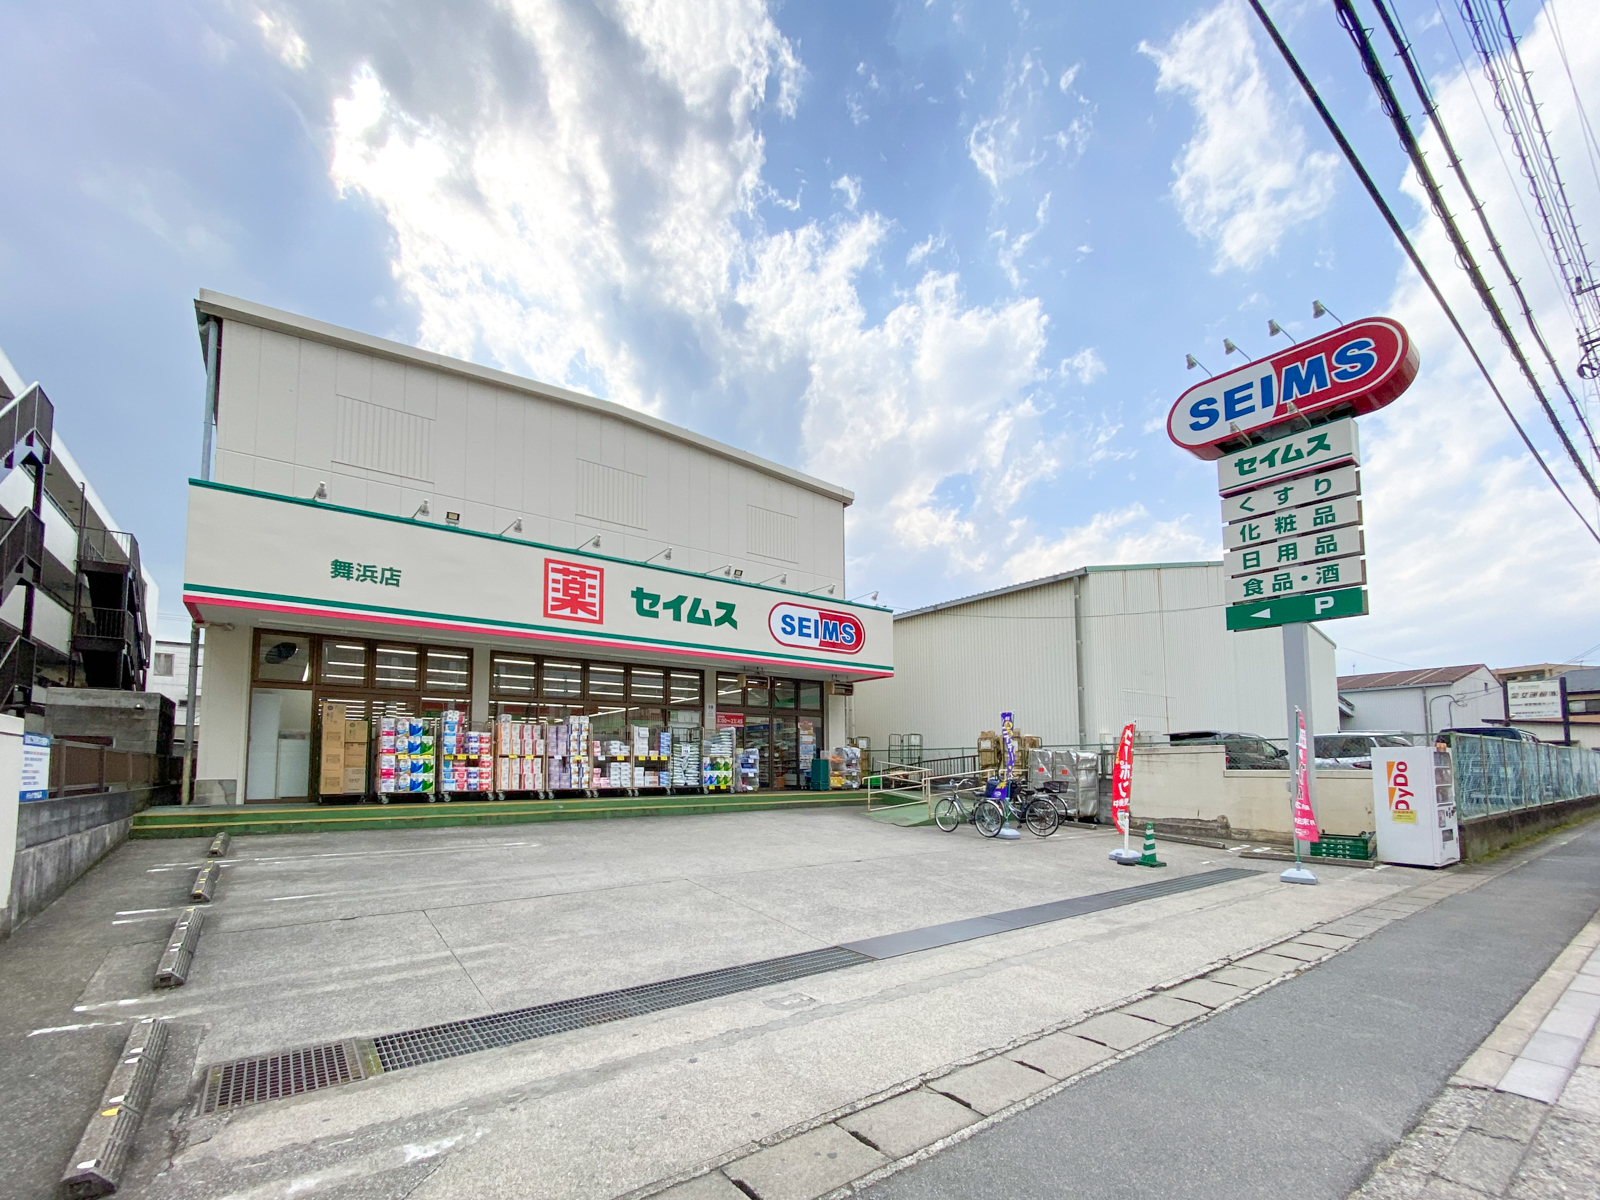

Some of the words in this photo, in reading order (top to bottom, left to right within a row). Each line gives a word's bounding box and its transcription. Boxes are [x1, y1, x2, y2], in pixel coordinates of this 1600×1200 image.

[1189, 337, 1378, 432] SEIMS
[1234, 433, 1331, 476] セイムス
[1239, 478, 1332, 512] くすり
[1240, 504, 1336, 542] 化粧品
[1243, 534, 1338, 570] 日用品
[330, 559, 402, 587] 舞浜店
[550, 566, 598, 618] 薬
[631, 587, 738, 630] セイムス
[1314, 596, 1335, 614] P
[781, 614, 856, 645] SEIMS
[1393, 761, 1414, 811] DyDo
